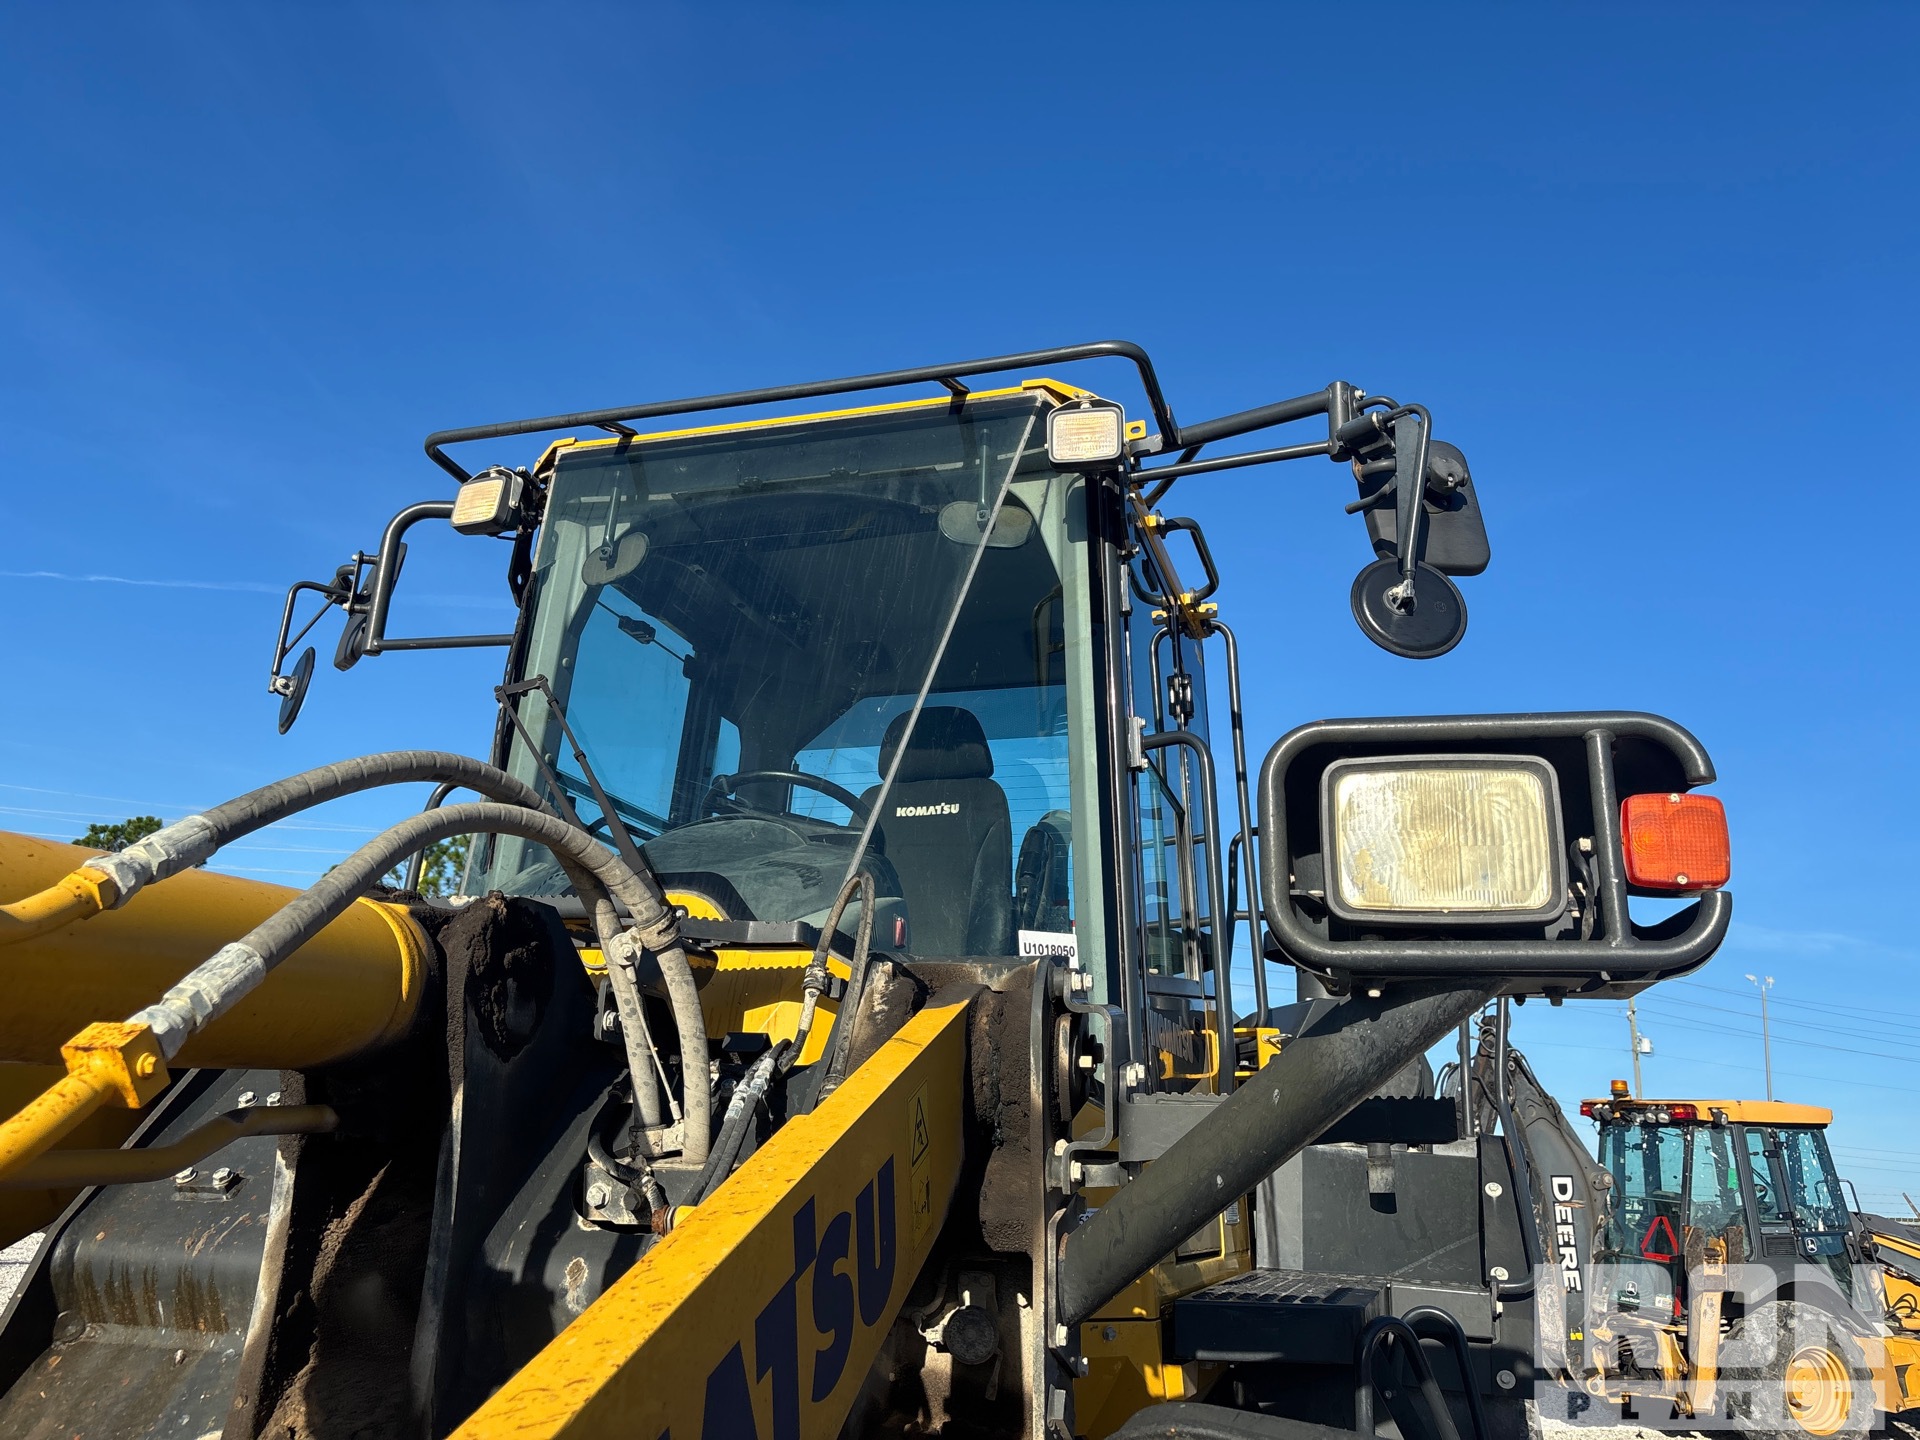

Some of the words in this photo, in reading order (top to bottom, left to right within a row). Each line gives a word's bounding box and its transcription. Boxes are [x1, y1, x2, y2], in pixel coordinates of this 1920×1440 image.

[896, 802, 960, 817] KOMATSU
[1023, 942, 1075, 957] U1018050
[1551, 1176, 1582, 1292] DEERE
